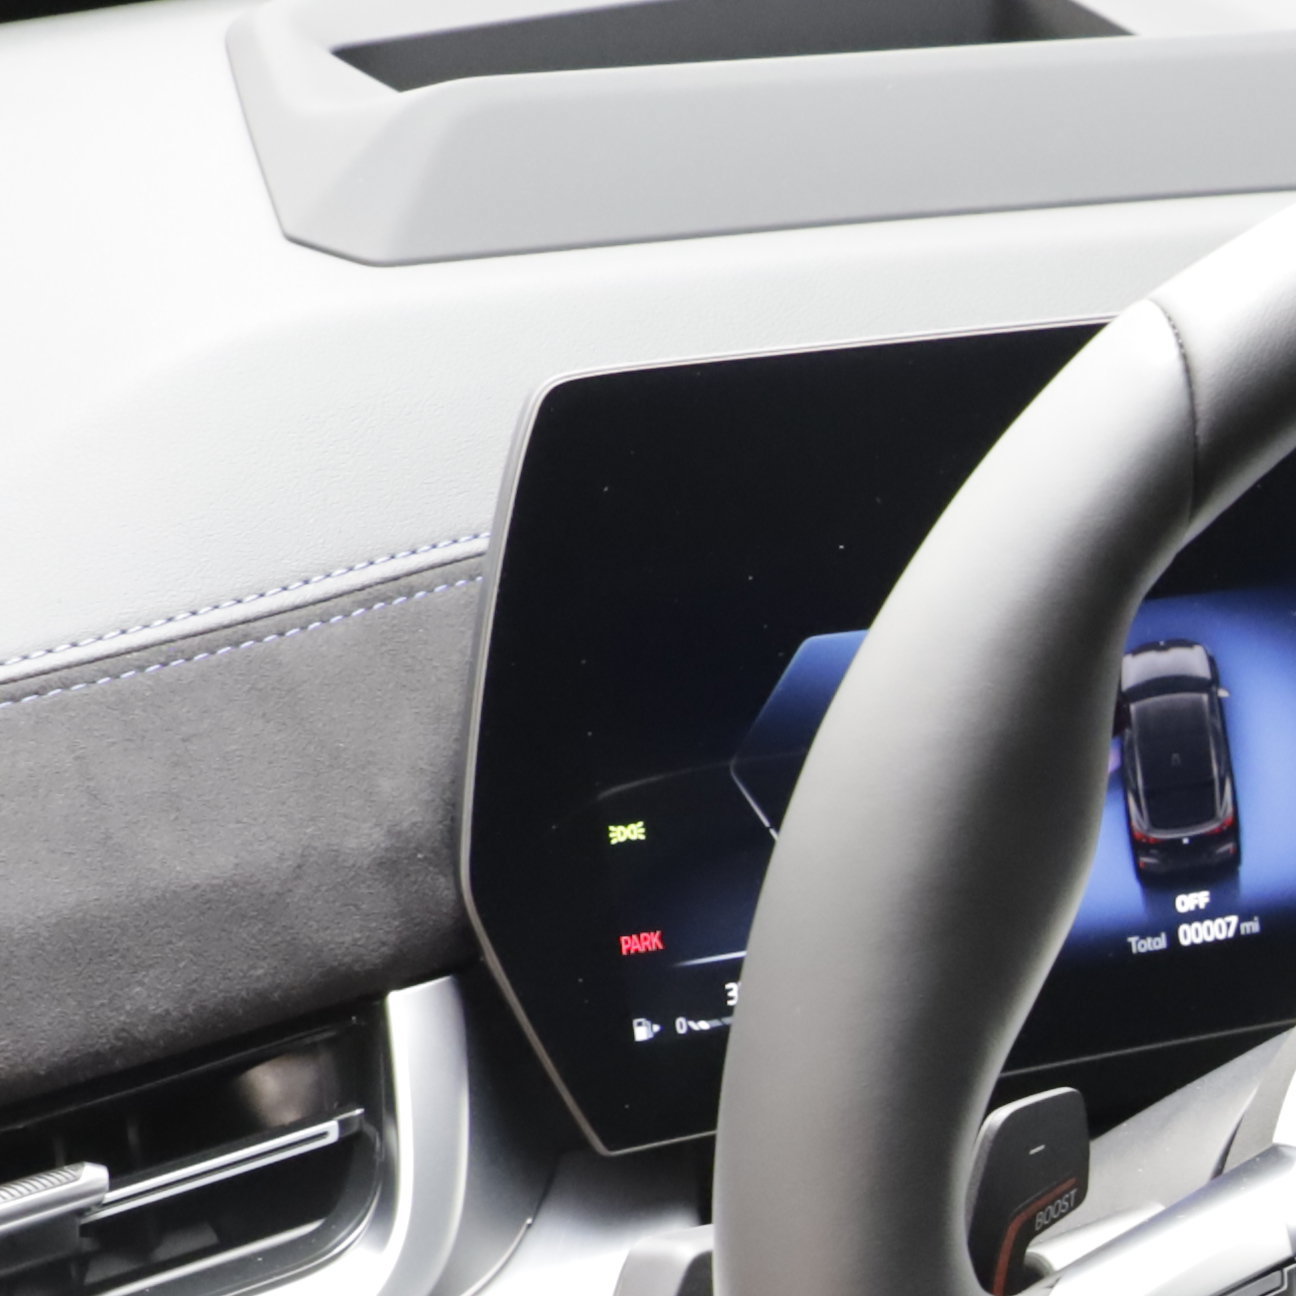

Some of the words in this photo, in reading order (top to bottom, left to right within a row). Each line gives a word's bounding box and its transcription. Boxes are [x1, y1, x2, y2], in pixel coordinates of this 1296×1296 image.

[1175, 890, 1210, 913] OFF
[620, 931, 664, 955] PARK
[1127, 931, 1167, 954] Total
[1178, 915, 1239, 946] 00007
[1239, 916, 1260, 936] mi
[1034, 1189, 1078, 1232] BOOST
